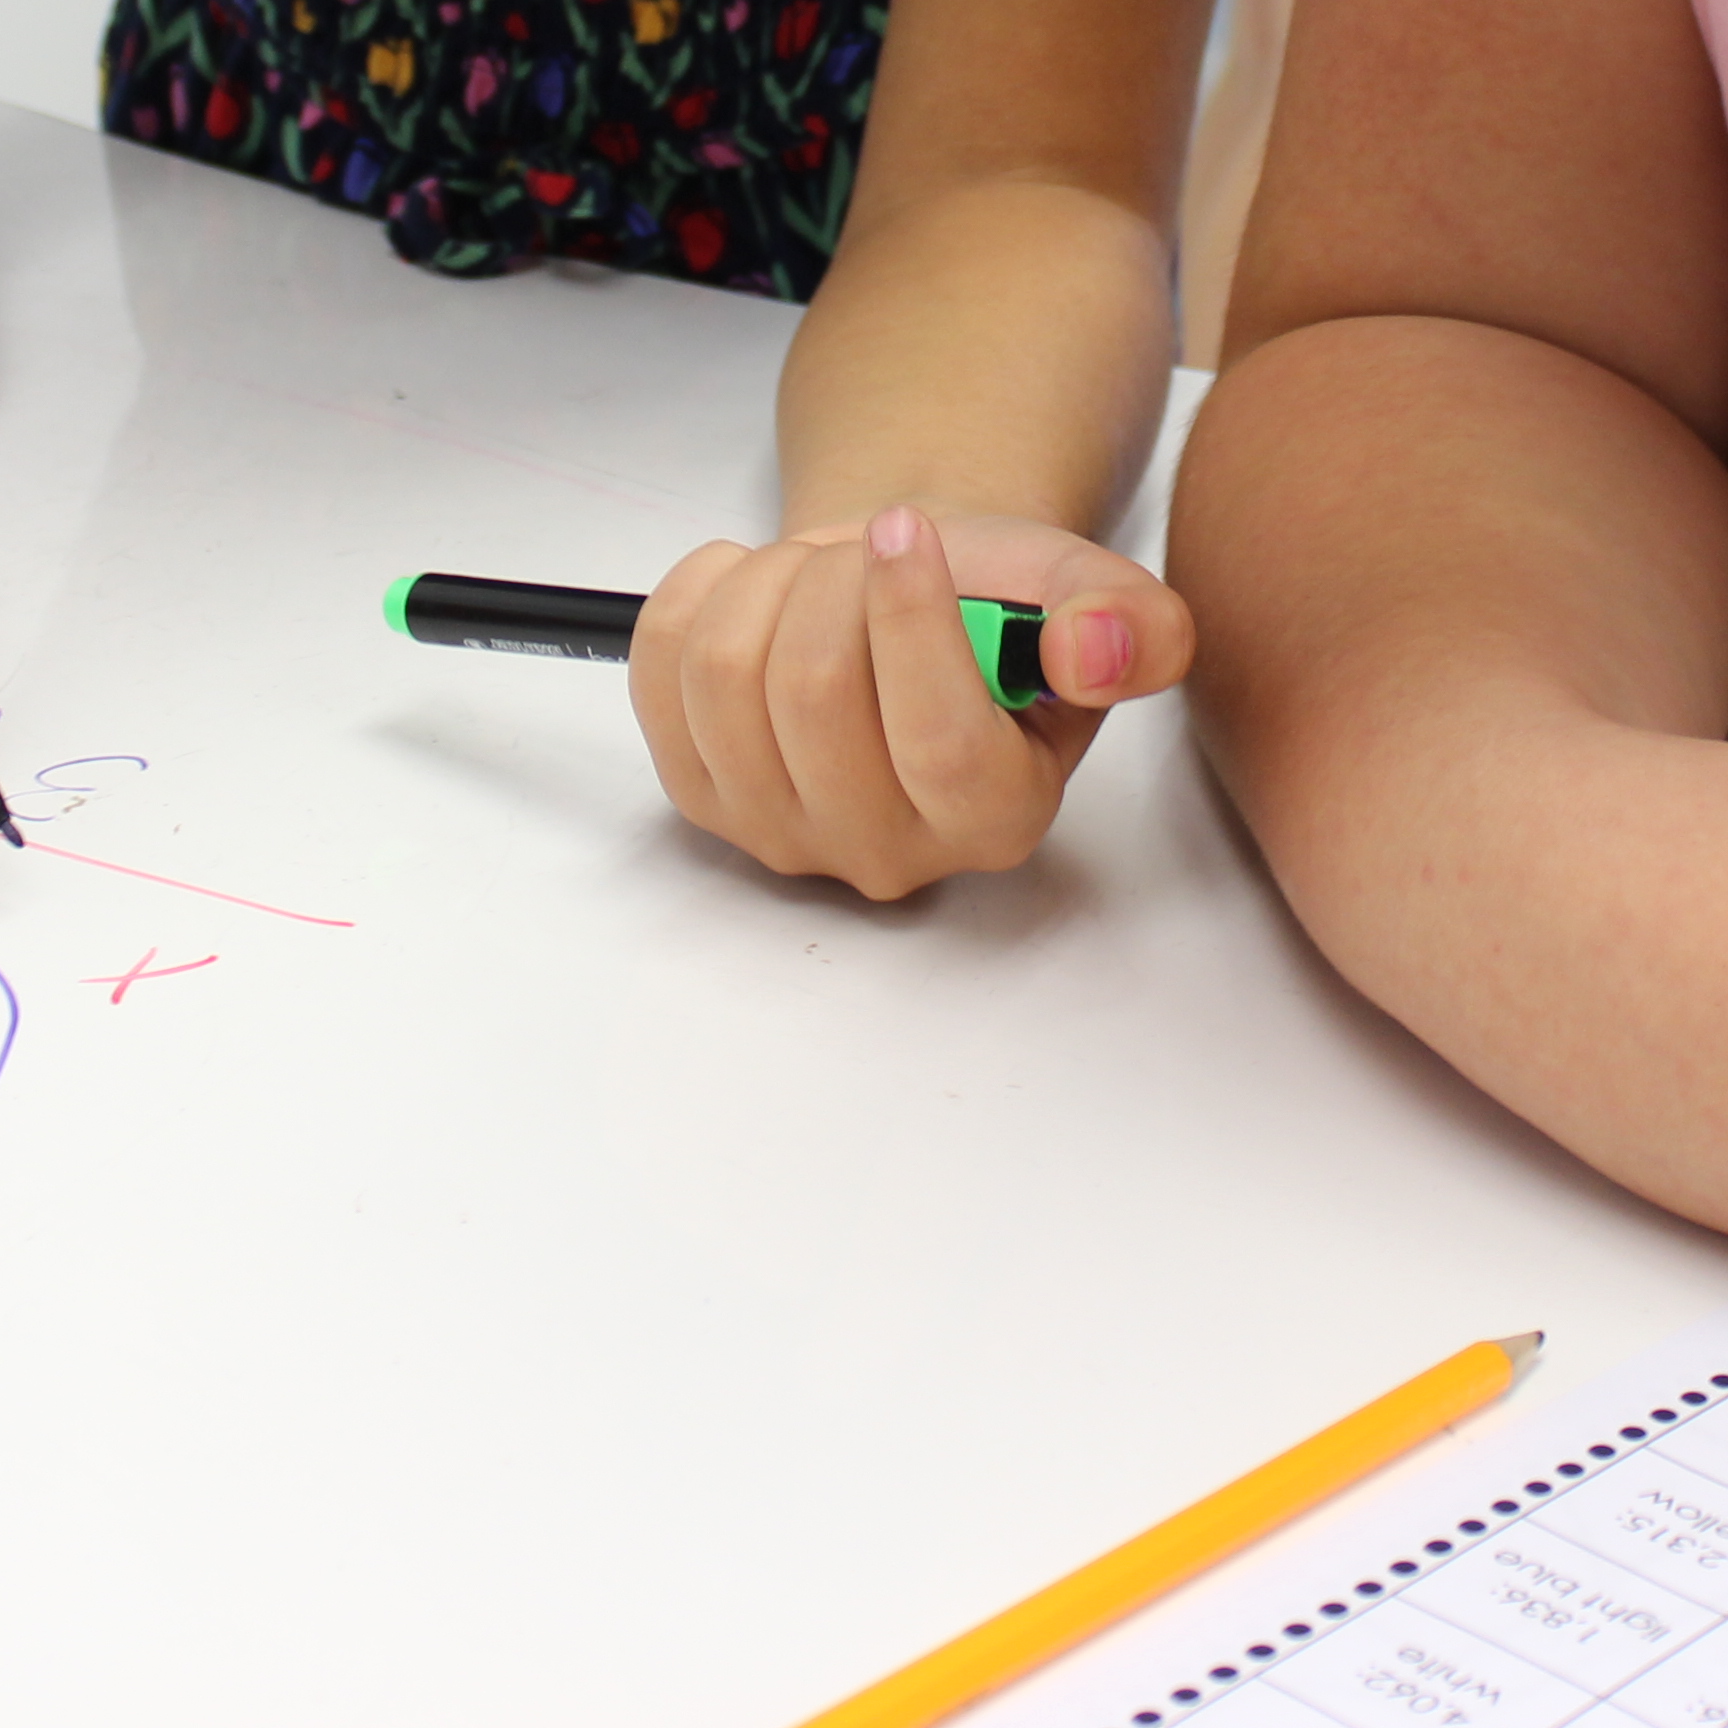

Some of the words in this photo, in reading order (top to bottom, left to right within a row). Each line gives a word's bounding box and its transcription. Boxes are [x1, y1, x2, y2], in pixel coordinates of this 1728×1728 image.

[1494, 1550, 1580, 1597] blue
[1582, 1593, 1672, 1644] light
[1397, 1647, 1502, 1707] white
